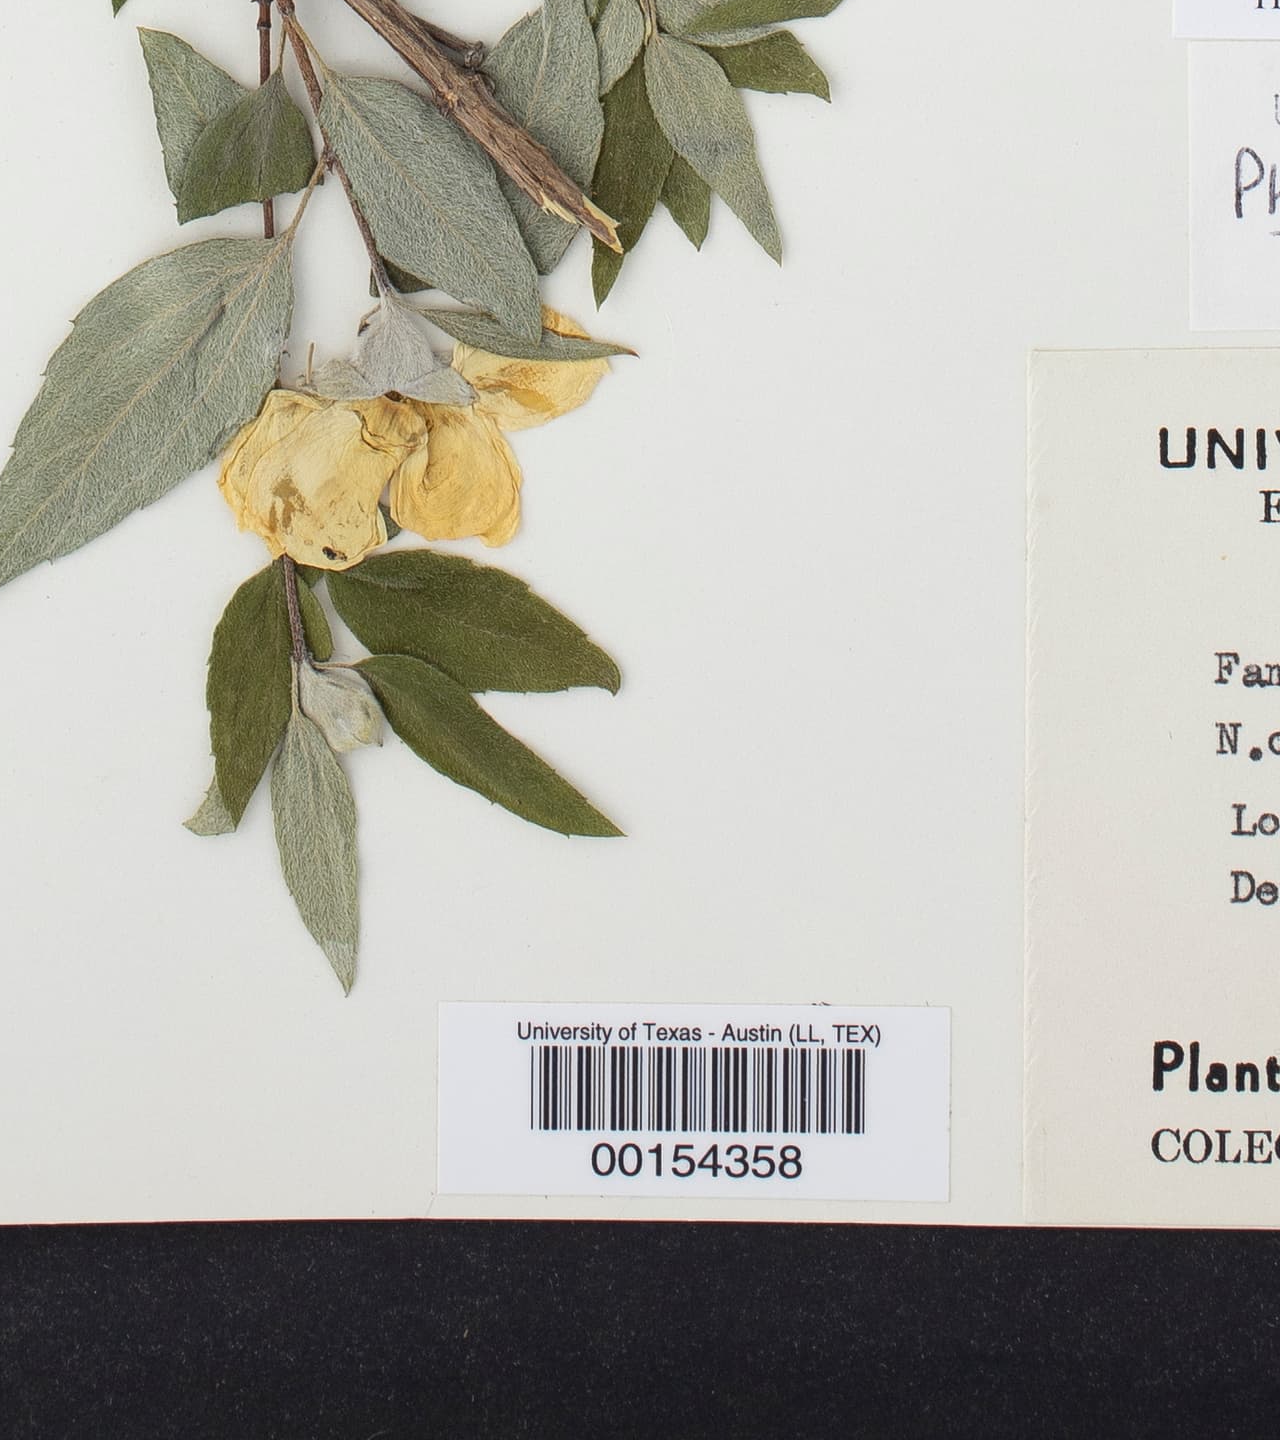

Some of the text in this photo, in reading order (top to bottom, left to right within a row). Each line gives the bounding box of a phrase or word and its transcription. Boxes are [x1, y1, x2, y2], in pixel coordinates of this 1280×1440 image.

[517, 1021, 613, 1045] University
[618, 1021, 638, 1041] of
[643, 1022, 703, 1042] Texas
[721, 1023, 782, 1043] Austin
[788, 1023, 825, 1047] (LL,
[831, 1024, 881, 1048] TEX)
[591, 1142, 803, 1180] 00154358
